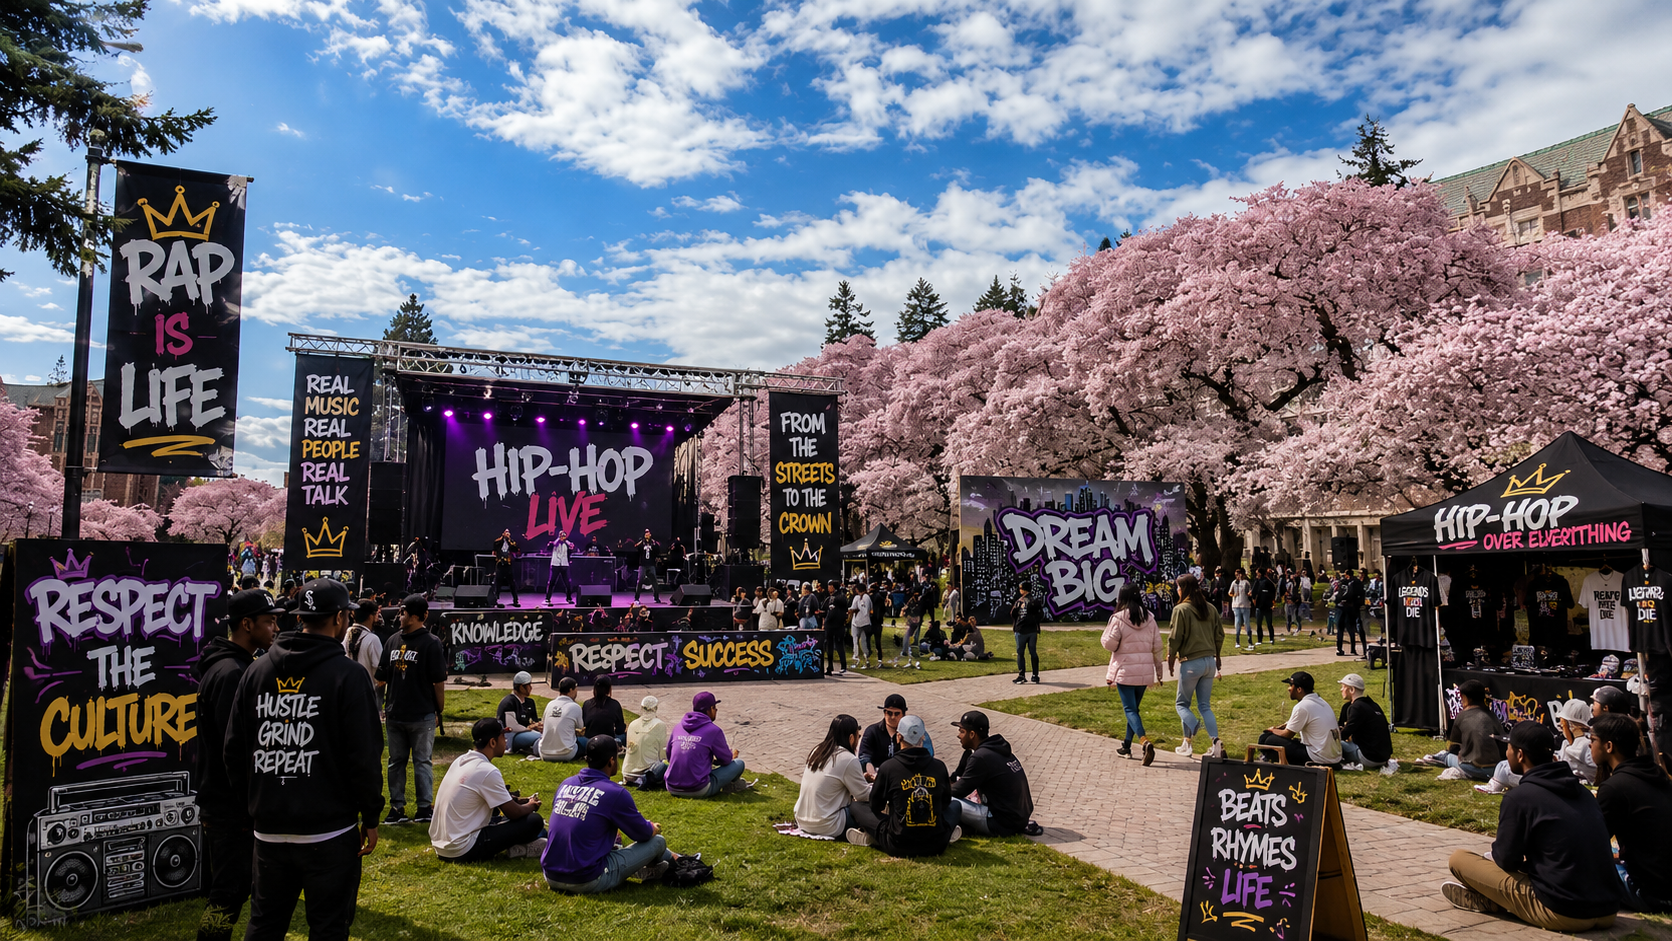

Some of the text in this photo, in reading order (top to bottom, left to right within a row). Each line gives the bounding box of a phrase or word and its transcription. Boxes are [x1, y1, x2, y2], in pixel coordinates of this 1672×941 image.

[120, 239, 235, 316] RAP
[155, 312, 193, 357] IS
[118, 362, 226, 435] LIFE
[306, 374, 355, 395] REAL
[305, 396, 360, 417] MUSIC
[303, 417, 352, 438] REAL
[780, 411, 826, 435] FROM
[301, 439, 361, 460] PEOPLE
[789, 436, 818, 458] THE
[300, 461, 351, 483] REAL
[471, 441, 654, 506] HIP-HOP
[775, 460, 836, 485] STREETS
[301, 484, 349, 507] TALK
[782, 487, 827, 508] TO THE
[522, 491, 608, 541] LIVE
[778, 511, 832, 535] CROWN
[1433, 495, 1579, 543] HIP-HOP
[1002, 512, 1154, 566] DREAM
[1483, 531, 1525, 550] OVER
[1045, 558, 1126, 607] BIG
[28, 577, 217, 645] RESPECT
[1406, 606, 1421, 618] DIE
[1637, 608, 1657, 621] DIE
[450, 620, 543, 645] KNOWLEDGE
[86, 644, 156, 691] THE
[568, 642, 669, 674] RESPECT
[682, 639, 775, 671] SUCCESS
[255, 692, 321, 720] HUSTLE
[39, 691, 197, 760] CULTURE
[258, 720, 314, 749] GRIND
[253, 748, 320, 776] REPEAT
[1217, 788, 1288, 828] BEATS
[1210, 826, 1297, 873] RHYMES
[1220, 867, 1273, 911] LIFE
